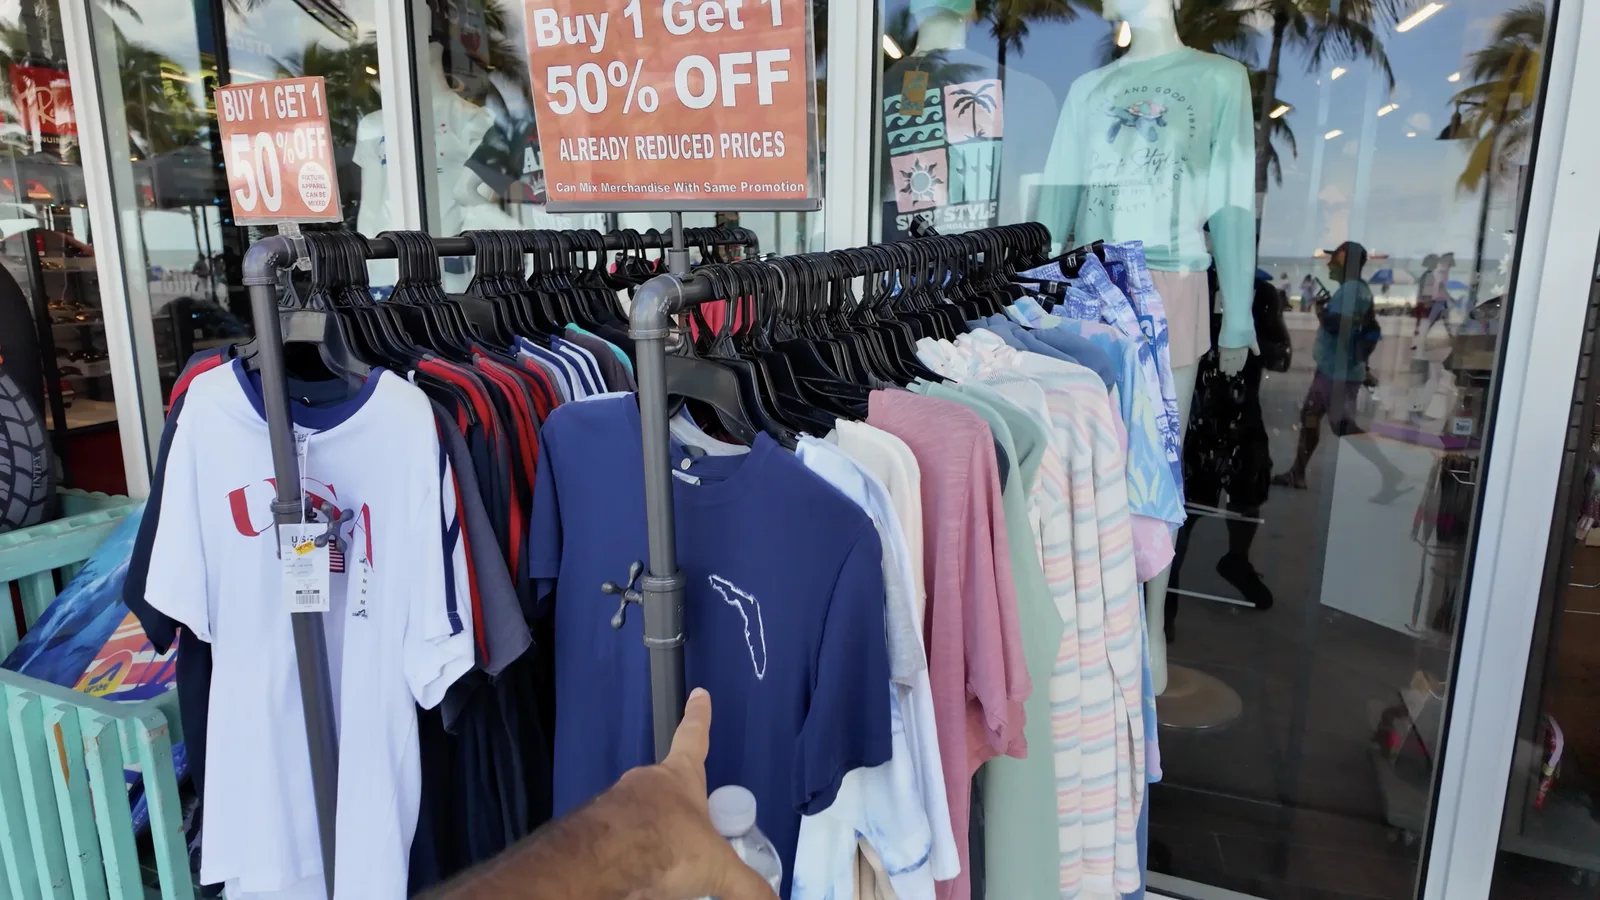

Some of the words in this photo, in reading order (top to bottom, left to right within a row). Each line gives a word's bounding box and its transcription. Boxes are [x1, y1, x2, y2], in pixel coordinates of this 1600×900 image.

[533, 8, 609, 54] Buy
[623, 0, 644, 39] 1
[661, 0, 744, 36] Get
[759, 0, 783, 27] 1
[546, 58, 660, 115] 50%
[674, 48, 791, 110] OFF
[1124, 85, 1148, 95] AND
[1155, 86, 1186, 102] GOOD
[221, 88, 254, 122] BUY
[260, 87, 270, 120] 1
[274, 84, 307, 119] GET
[312, 82, 323, 117] 1
[293, 127, 326, 160] OFF
[559, 135, 629, 161] ALREADY
[636, 133, 714, 160] REDUCED
[720, 130, 785, 159] PRICES
[555, 182, 577, 193] Can
[579, 182, 598, 193] Mix
[601, 182, 671, 193] Merchandise
[674, 182, 700, 193] With
[703, 182, 737, 193] Same
[741, 181, 805, 193] Promotion
[943, 202, 998, 223] STYLE
[32, 454, 42, 488] INTEX
